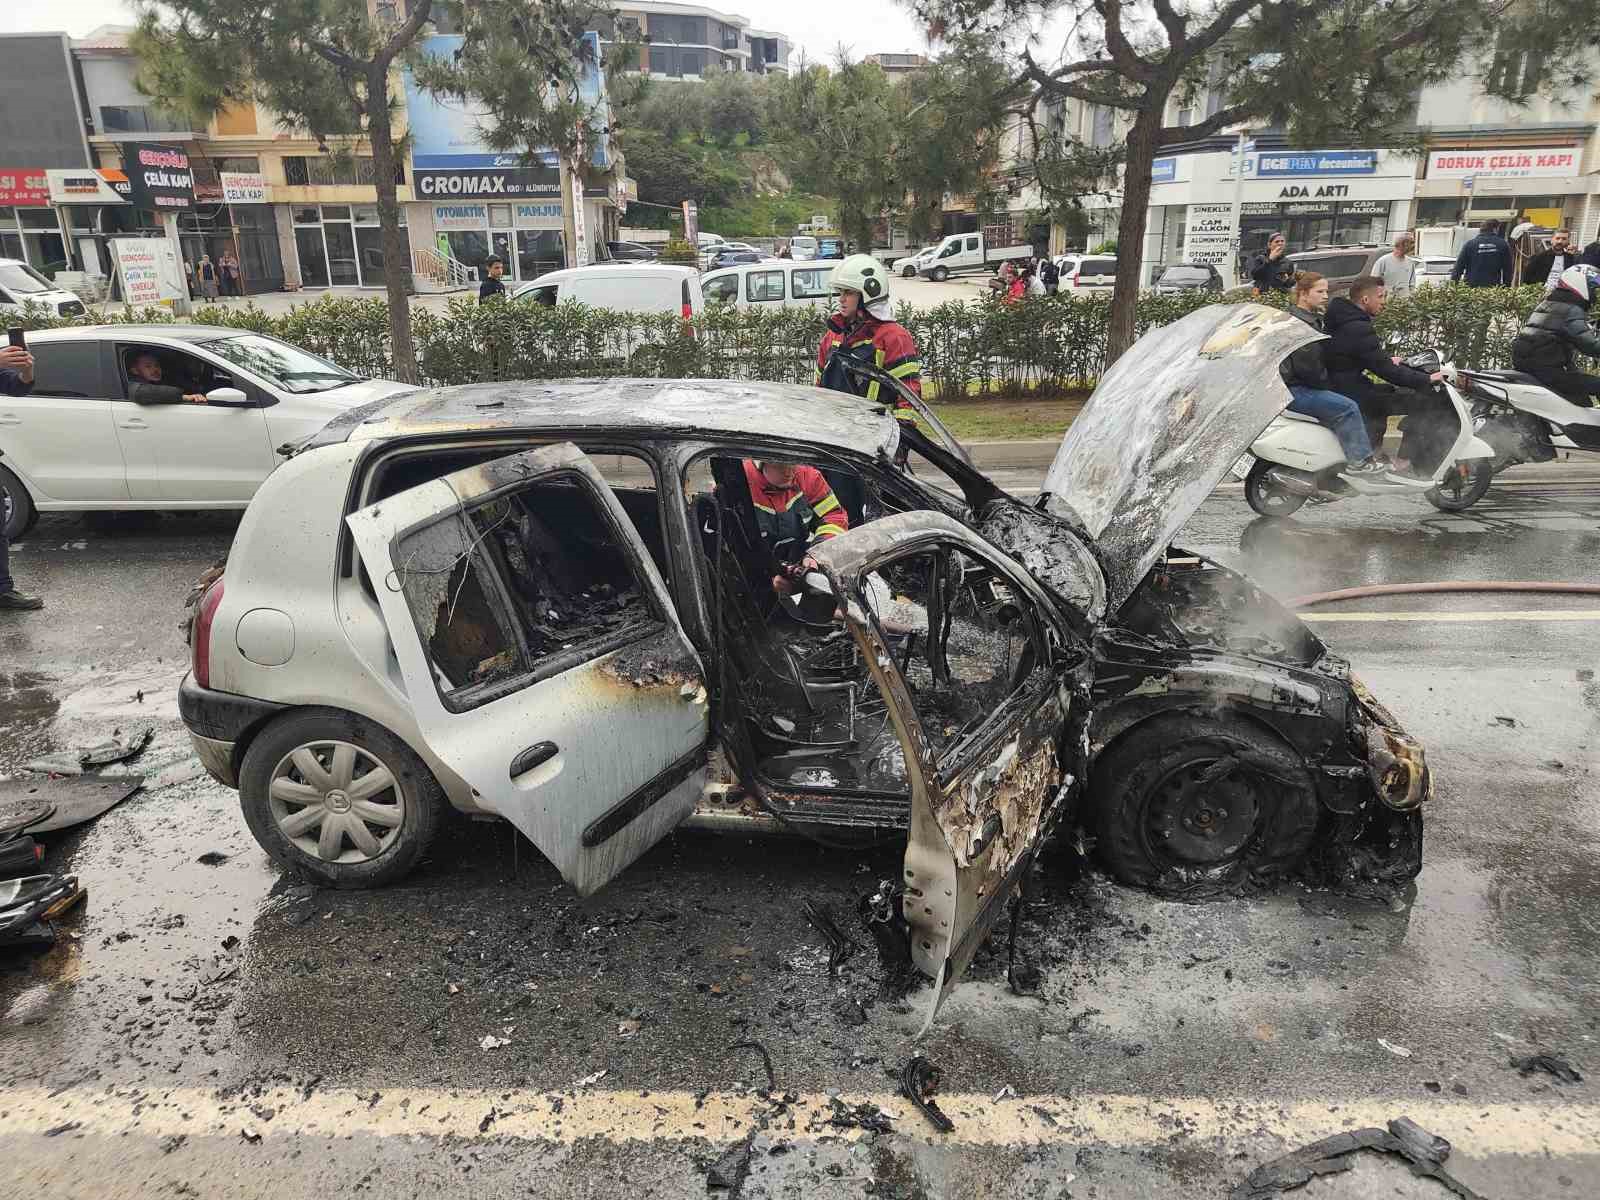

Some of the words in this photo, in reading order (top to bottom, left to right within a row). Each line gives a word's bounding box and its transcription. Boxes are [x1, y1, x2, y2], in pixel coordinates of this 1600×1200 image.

[1436, 157, 1485, 169] DORUK
[1489, 155, 1533, 170] ÇELİK
[1536, 154, 1573, 167] KAPI
[144, 170, 170, 188] ÇELİK
[170, 173, 192, 188] KAPI
[420, 176, 505, 194] CROMAX
[1279, 186, 1309, 198] ADA
[1314, 185, 1349, 197] ARTI
[436, 204, 486, 217] OTOMATİK
[1193, 205, 1232, 213] SİNEKLİK
[1188, 250, 1228, 258] OTOMATİK
